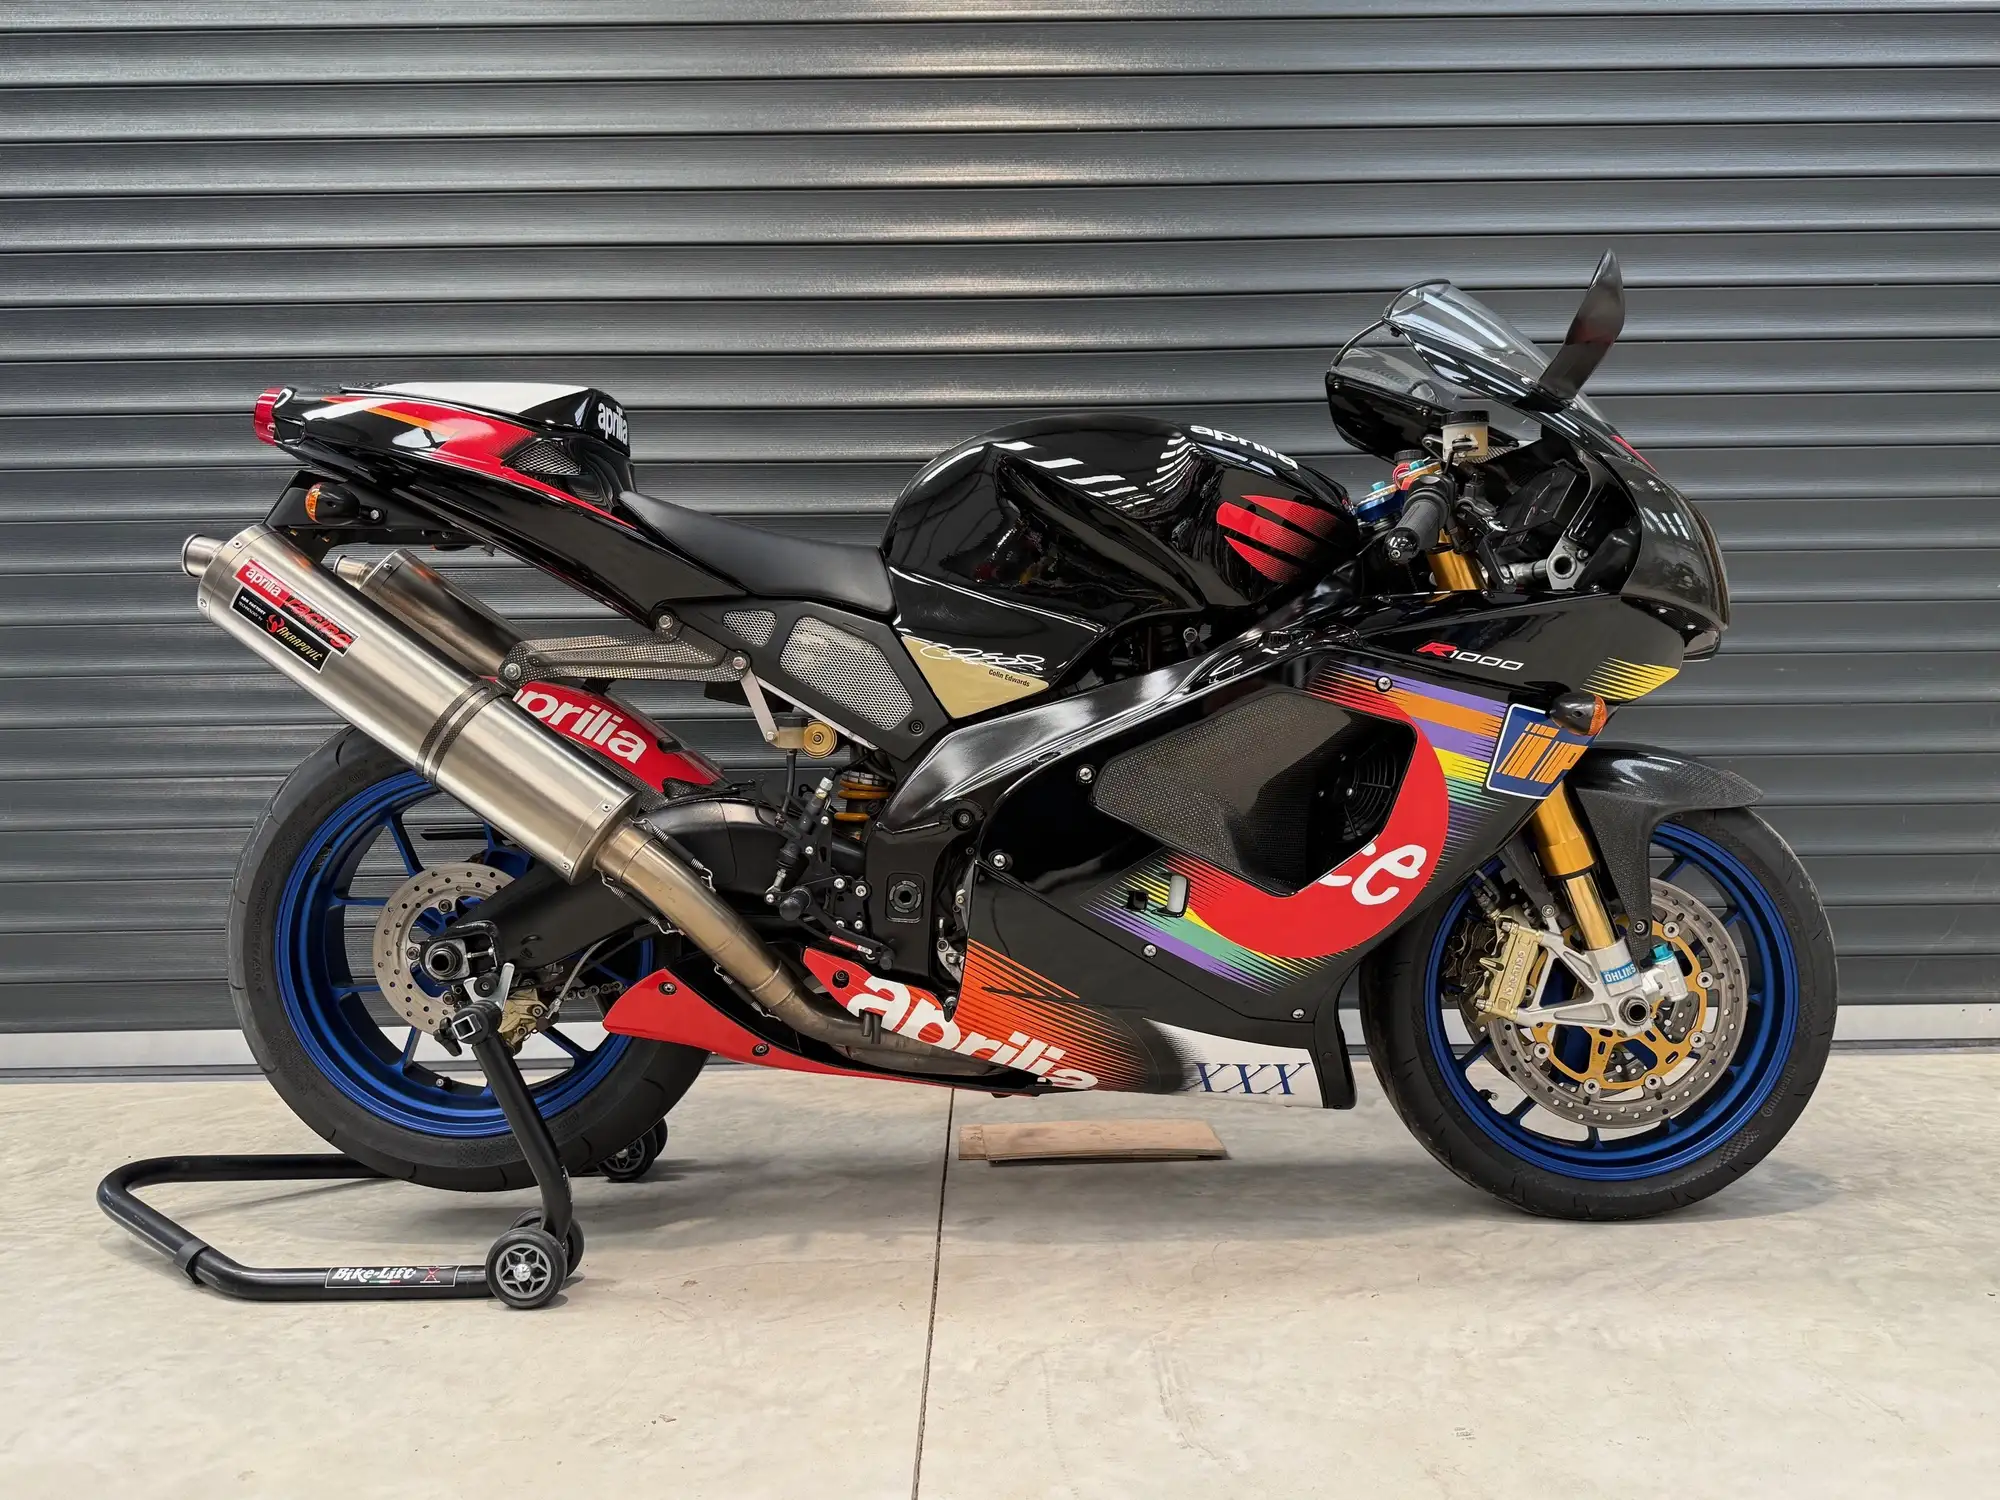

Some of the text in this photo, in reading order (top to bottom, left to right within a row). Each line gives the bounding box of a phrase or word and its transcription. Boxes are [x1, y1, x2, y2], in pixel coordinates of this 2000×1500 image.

[598, 402, 628, 446] aprilia
[245, 567, 353, 648] aprilia racing
[988, 669, 1030, 688] Colin Edwards
[512, 688, 647, 764] prilia
[1504, 950, 1526, 998] brembo
[1603, 963, 1637, 983] ÖHLINS
[1178, 1062, 1310, 1096] XXX
